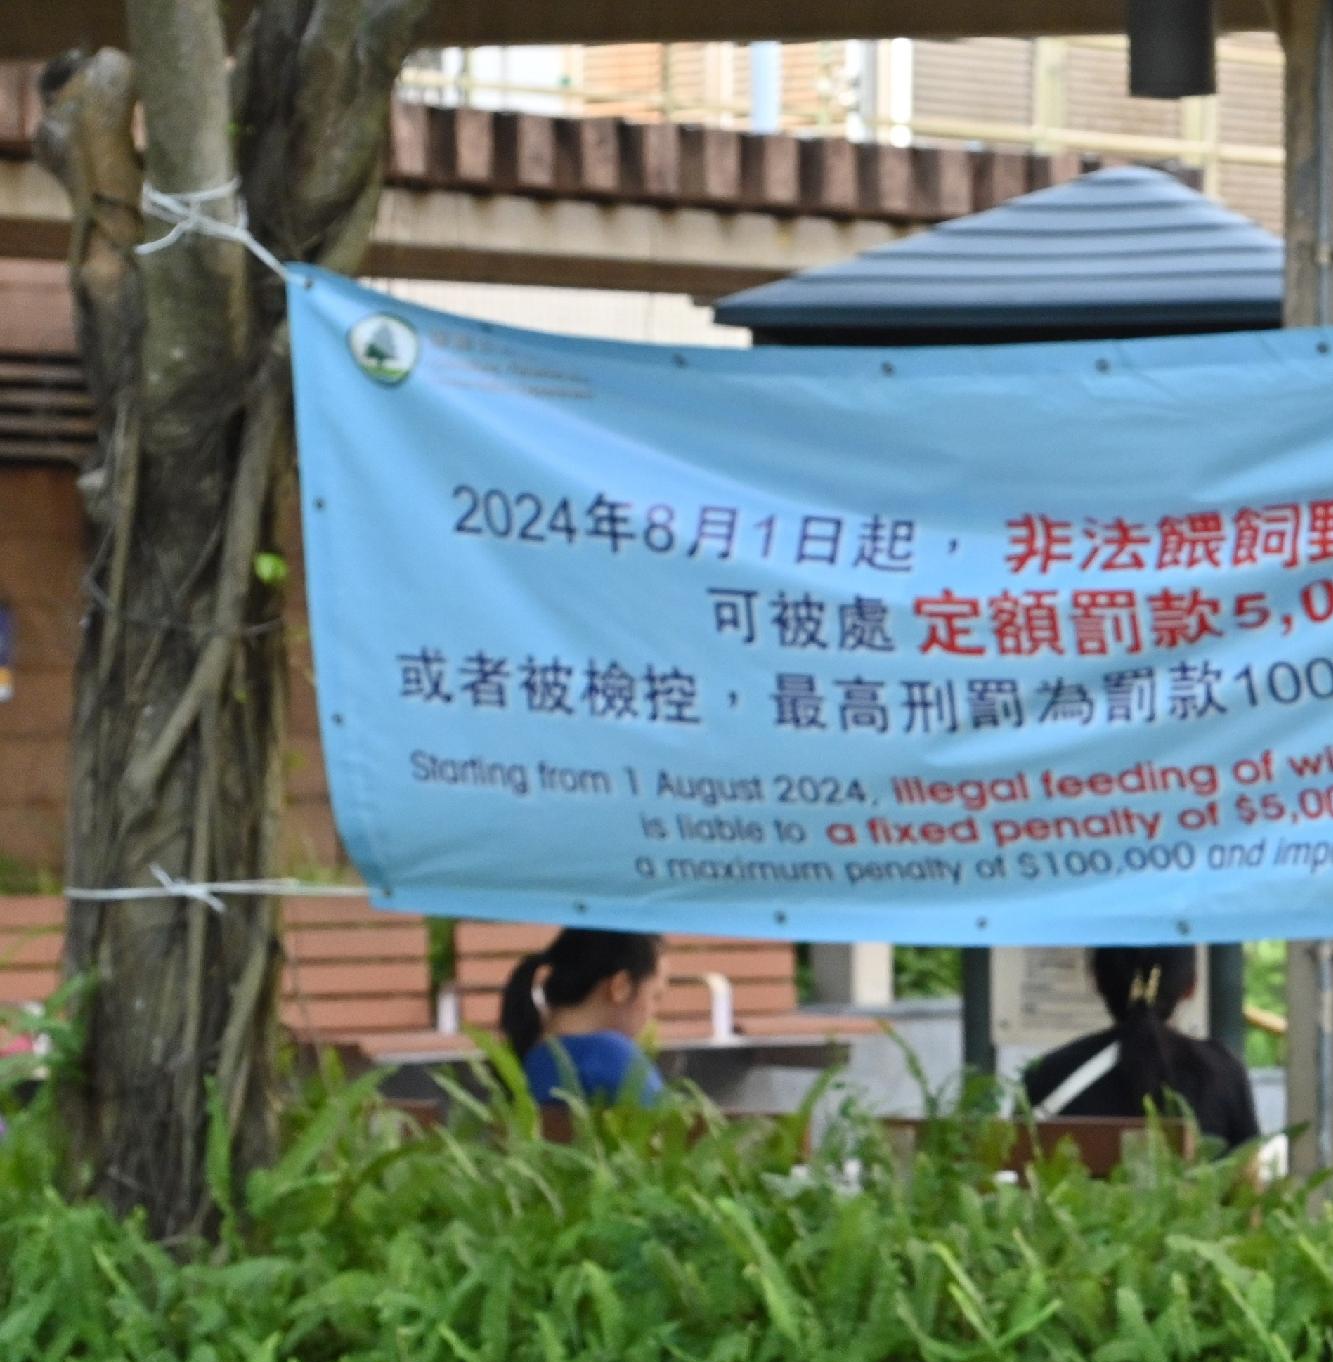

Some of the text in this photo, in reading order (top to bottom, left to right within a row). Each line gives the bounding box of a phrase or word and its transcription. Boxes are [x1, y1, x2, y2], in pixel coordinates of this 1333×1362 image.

[706, 586, 895, 652] 可被處
[410, 748, 530, 795] Starting
[538, 761, 611, 794] from
[624, 766, 640, 795] 1
[656, 770, 765, 806] August
[774, 774, 879, 807] 2024,
[892, 773, 1029, 810] illegal
[1040, 760, 1219, 796] feeding
[1232, 750, 1275, 785] of
[640, 812, 669, 840] is
[676, 813, 765, 844] liable
[775, 818, 806, 843] to
[825, 820, 857, 847] a
[867, 815, 980, 845] fixed
[993, 807, 1160, 848] penalty
[1178, 801, 1220, 831] of
[635, 854, 658, 880] a
[667, 857, 834, 884] maximum
[845, 858, 962, 884] penalty
[975, 854, 1005, 880] of
[1018, 839, 1196, 881] $100,000
[1207, 838, 1267, 868] and
